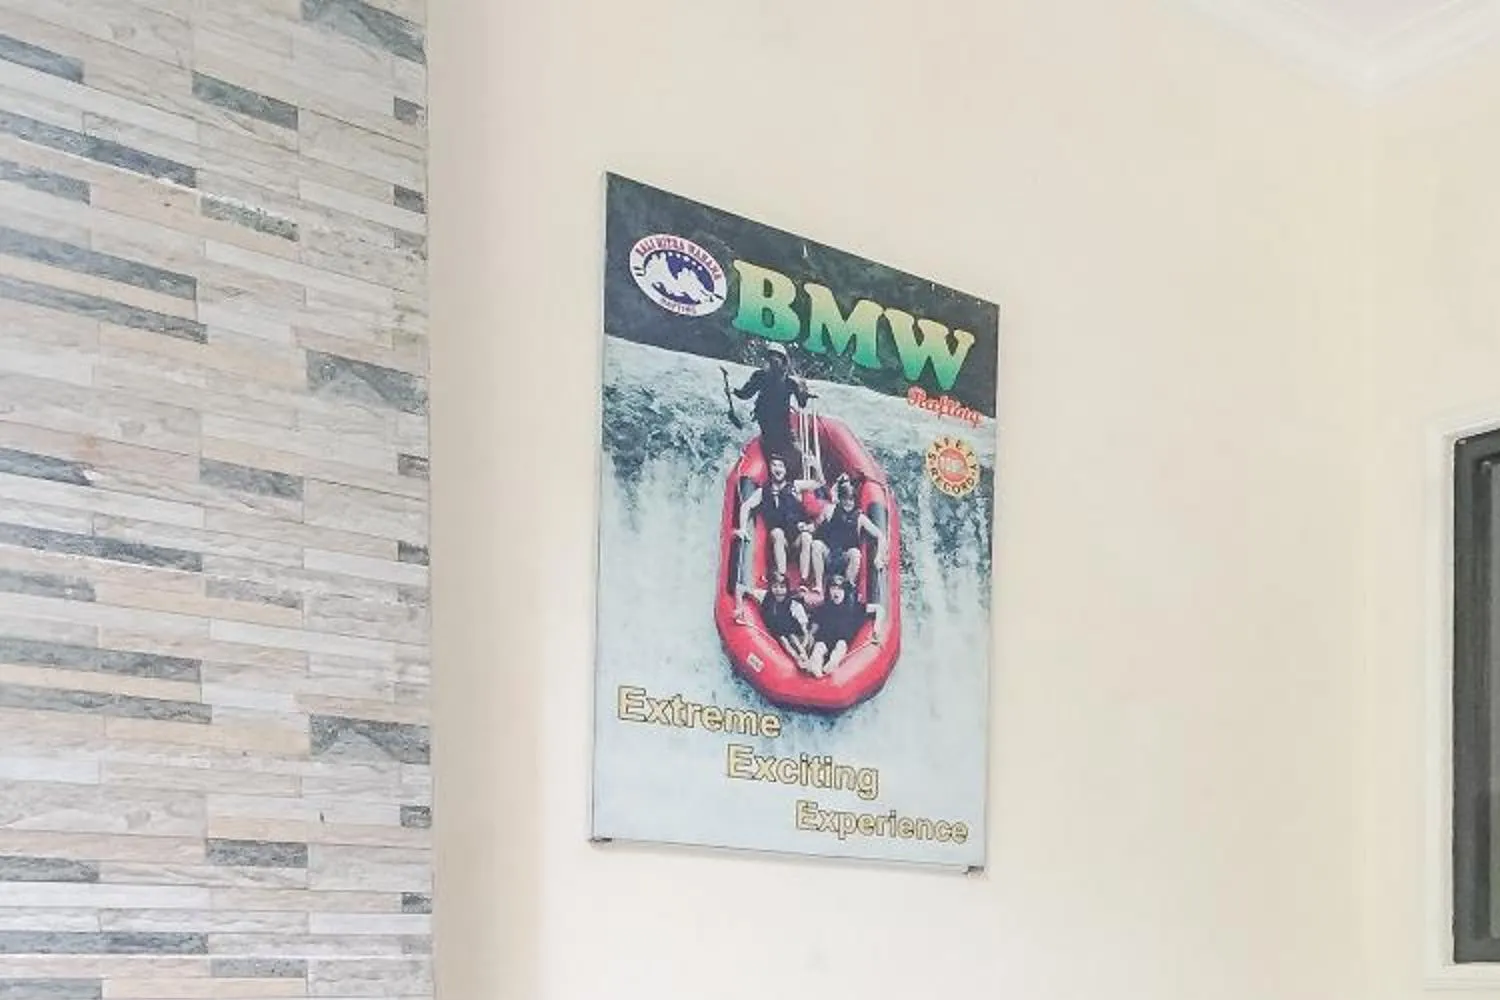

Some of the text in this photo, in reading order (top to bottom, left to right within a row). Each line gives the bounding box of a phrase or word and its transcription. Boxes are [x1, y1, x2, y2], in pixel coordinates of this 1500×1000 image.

[731, 259, 976, 392] BMW
[907, 385, 985, 429] Rafting
[617, 685, 782, 738] Extreme
[727, 743, 879, 800] Exciting
[794, 800, 969, 844] Experience
